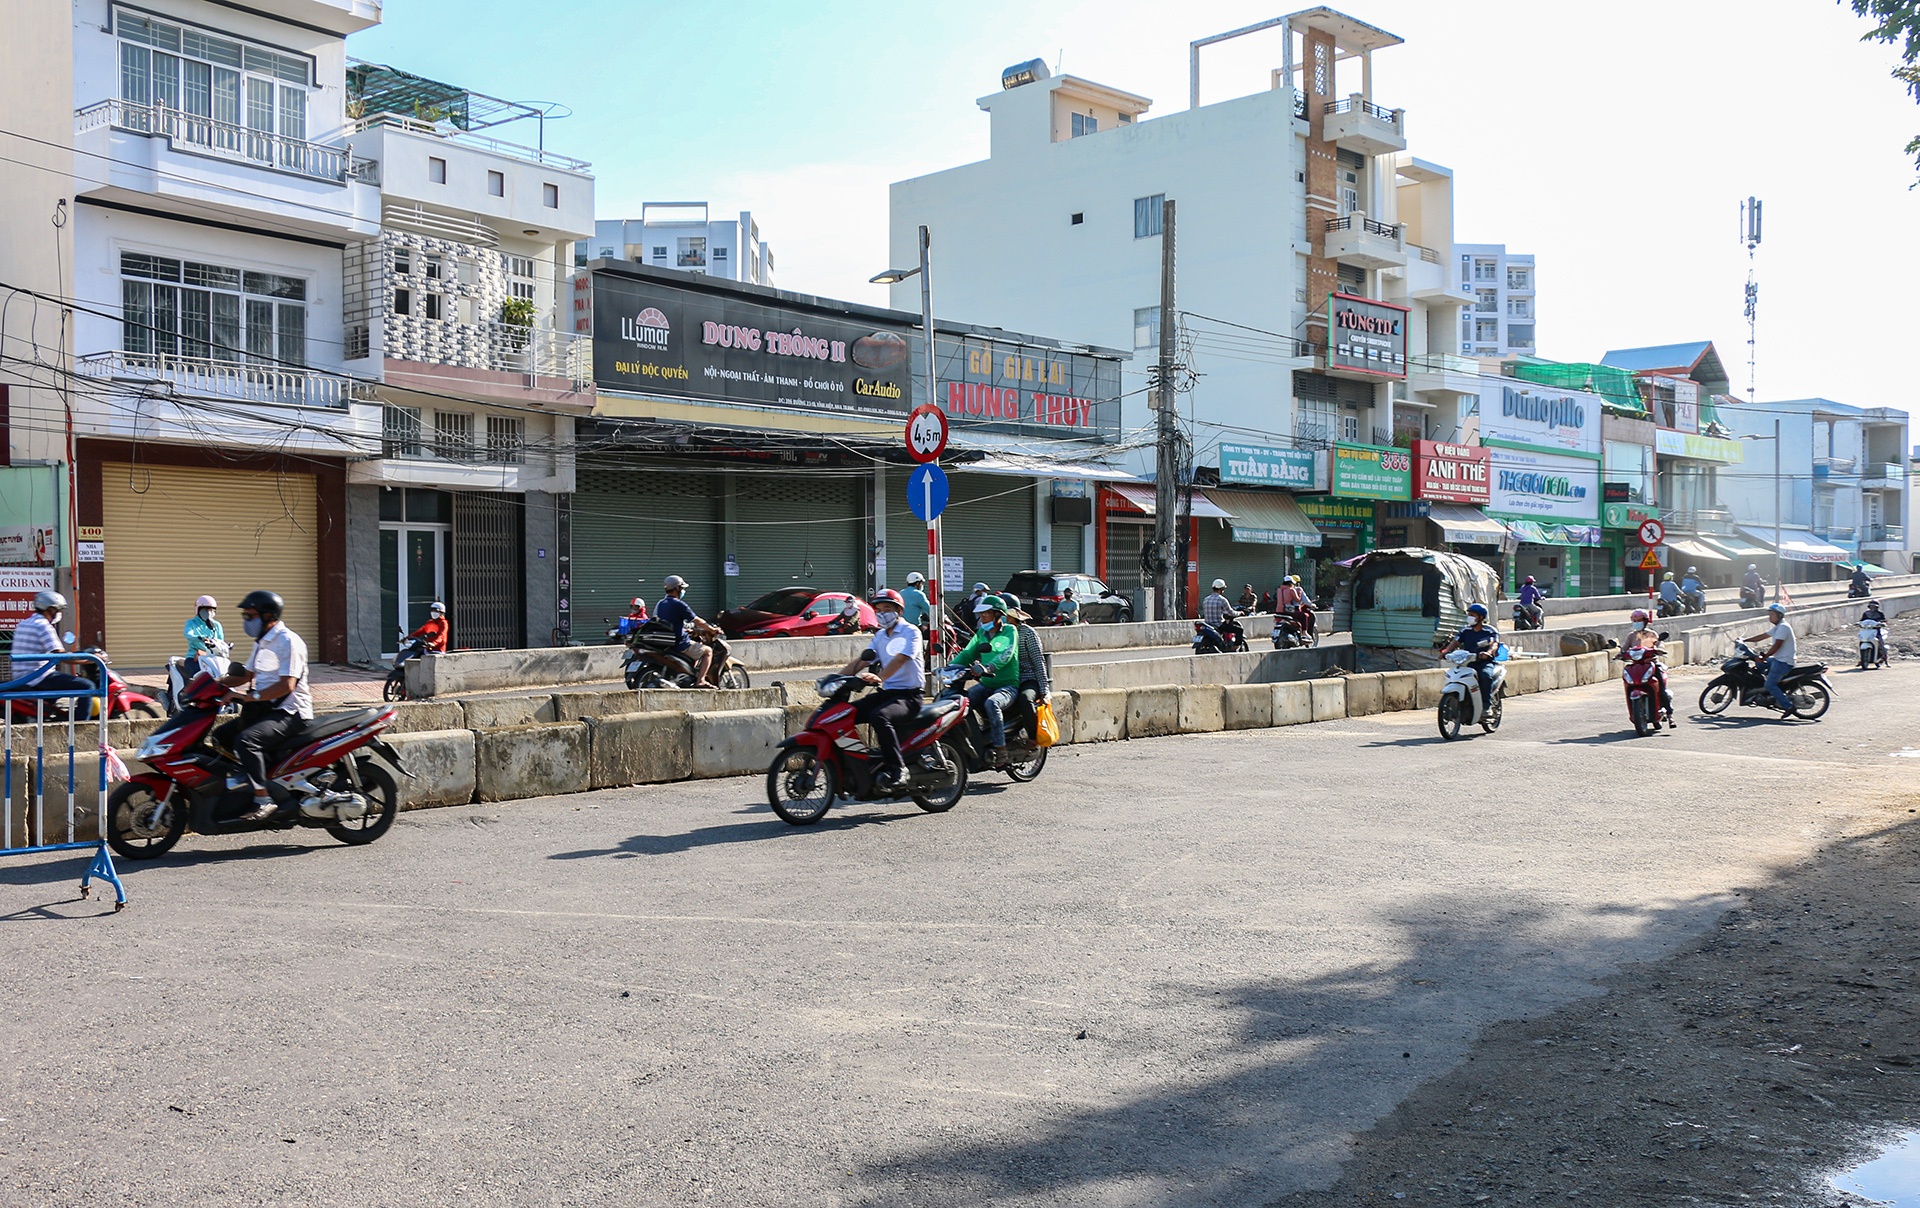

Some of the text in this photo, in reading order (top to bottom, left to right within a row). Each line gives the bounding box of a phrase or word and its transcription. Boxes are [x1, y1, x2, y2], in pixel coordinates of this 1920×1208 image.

[622, 317, 670, 345] LLumar
[1339, 309, 1391, 334] TÙNG TD
[704, 320, 762, 352] DUNG
[766, 328, 829, 361] THÔNG
[616, 360, 688, 381] ĐẠI LÝ ĐỘC QUYỀN
[776, 377, 798, 388] THANH
[1004, 356, 1032, 381] GIA
[1038, 361, 1065, 384] LAI
[948, 382, 1092, 427] HƯNG THỦY
[1504, 386, 1584, 430] Dunlopillo
[1381, 450, 1410, 472] 388
[1428, 460, 1456, 479] ANH
[1460, 456, 1486, 481] THẾ
[1106, 498, 1119, 508] CÔNG
[1120, 499, 1126, 508] TY
[0, 578, 51, 588] GRIBANK
